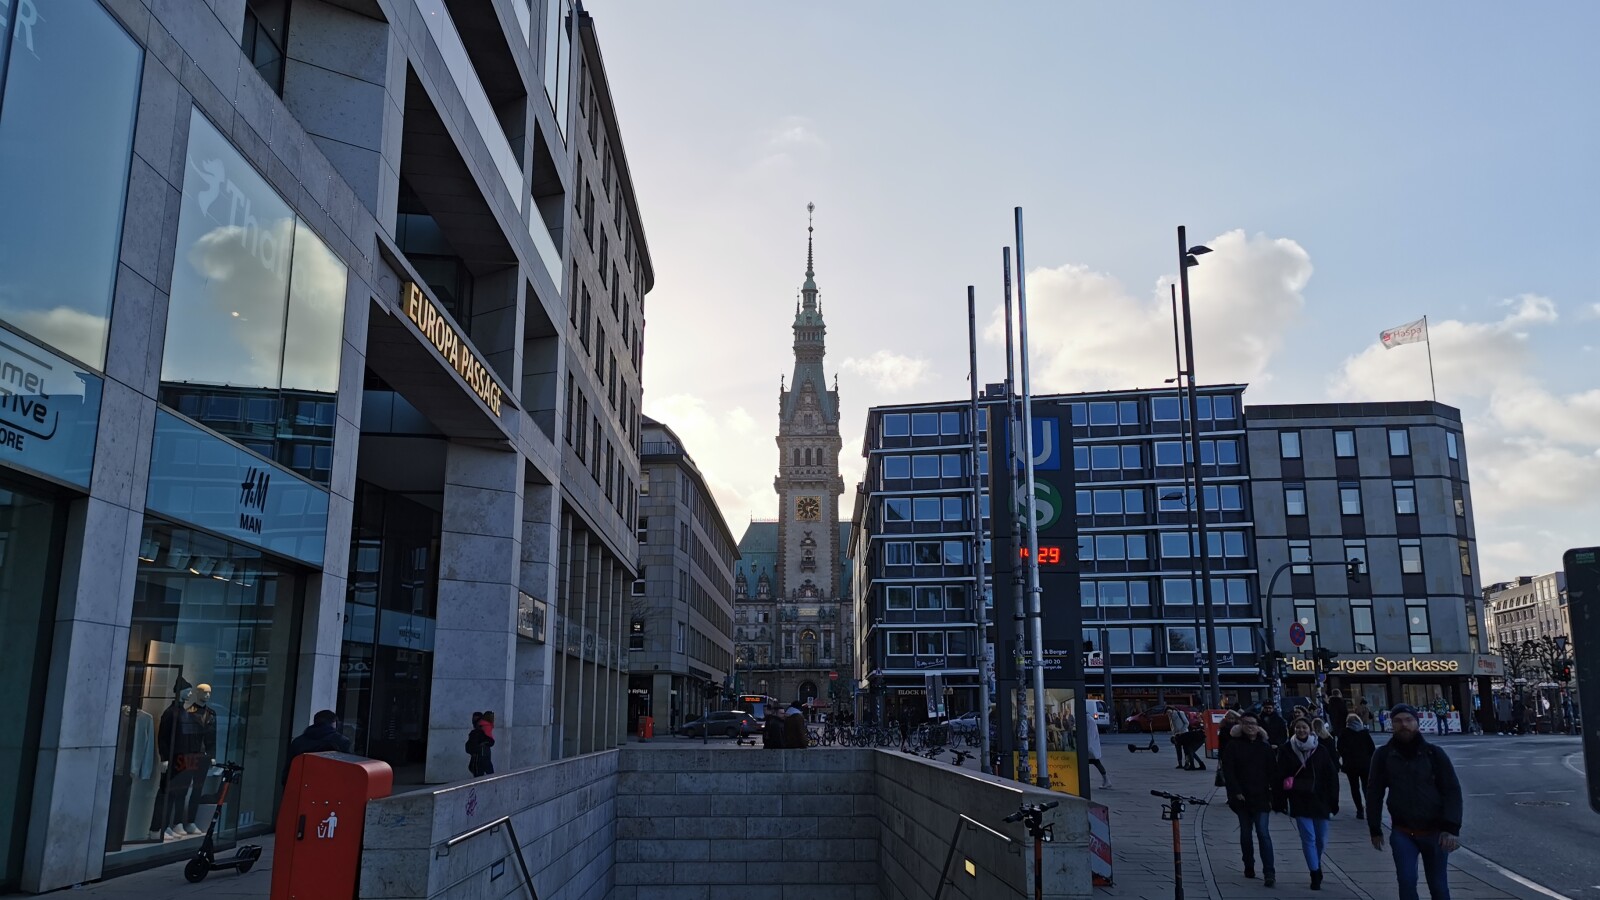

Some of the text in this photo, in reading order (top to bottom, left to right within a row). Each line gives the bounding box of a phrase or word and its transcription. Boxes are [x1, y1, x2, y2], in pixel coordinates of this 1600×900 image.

[409, 282, 502, 417] EUROPA PASSAGE
[1393, 327, 1422, 338] Haspa
[1014, 420, 1052, 466] U
[240, 465, 271, 514] H&M
[1017, 481, 1055, 527] S
[240, 512, 263, 535] MAN
[1284, 657, 1372, 674] Hamurger
[1374, 656, 1459, 675] Sparkasse
